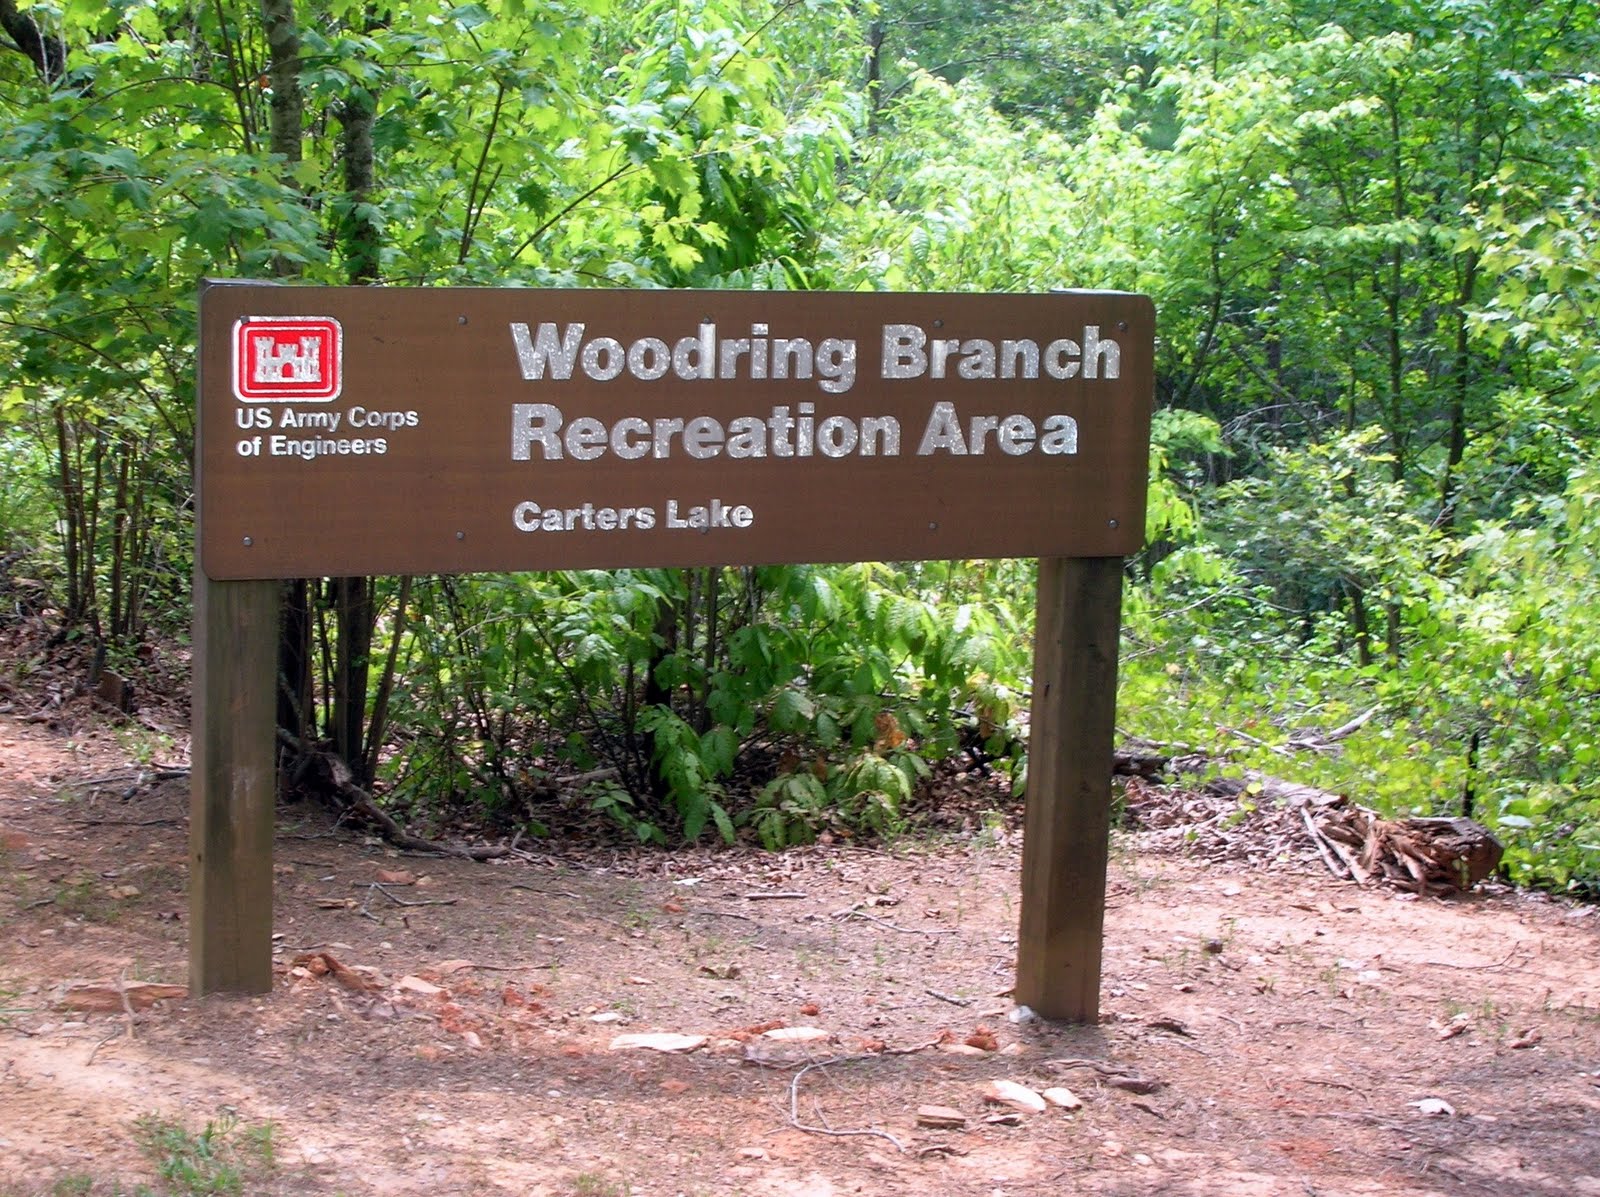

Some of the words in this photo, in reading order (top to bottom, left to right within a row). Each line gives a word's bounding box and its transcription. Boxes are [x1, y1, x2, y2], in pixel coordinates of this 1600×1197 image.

[510, 323, 857, 393] Woodring
[882, 324, 1121, 380] Branch
[236, 407, 273, 429] US
[279, 408, 342, 432] Army
[347, 406, 419, 431] Corps
[511, 402, 901, 461] Recreation
[918, 401, 1078, 456] Area
[236, 436, 263, 457] of
[270, 435, 388, 460] Engineers
[513, 500, 657, 532] Carters
[666, 499, 754, 529] Lake
